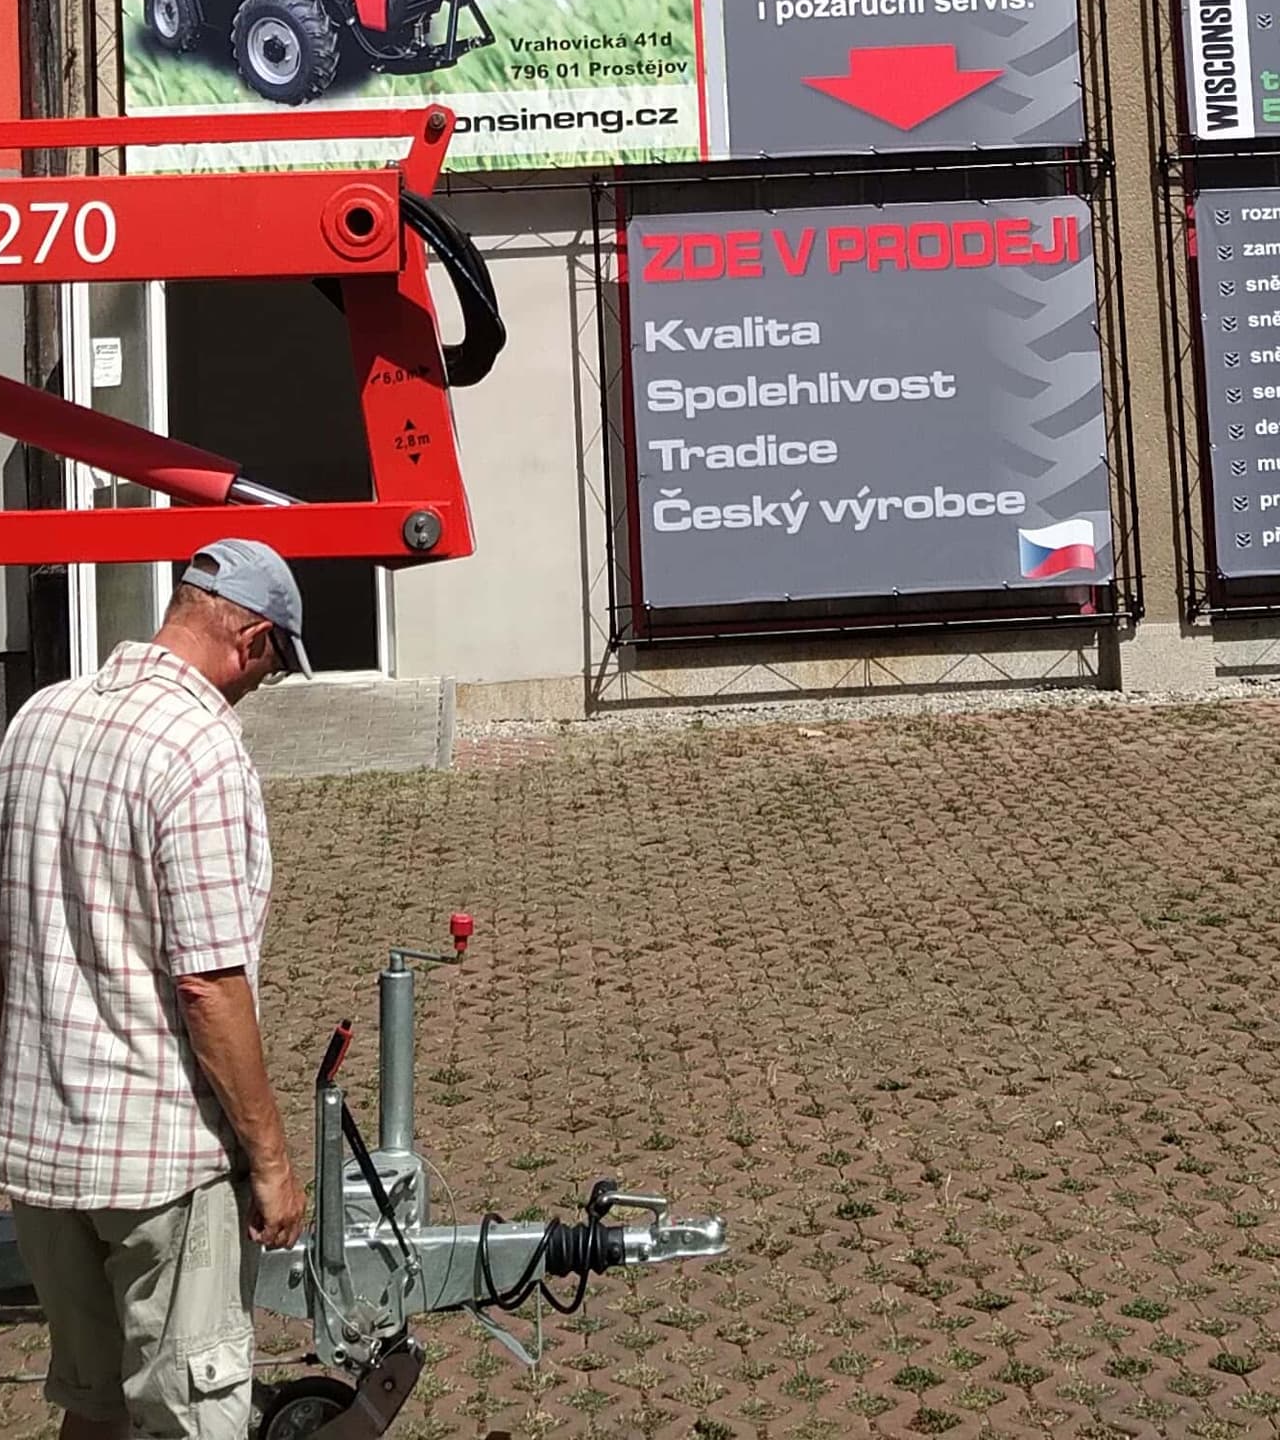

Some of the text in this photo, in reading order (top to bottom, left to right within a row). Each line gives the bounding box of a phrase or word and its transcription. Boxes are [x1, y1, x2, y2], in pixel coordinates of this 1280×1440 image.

[509, 32, 672, 52] Vrahovická 41d
[511, 60, 688, 80] 796 01 Prostějov
[453, 108, 678, 134] onsineng.cz
[641, 216, 1080, 283] ZDE V PRODEJI
[644, 315, 821, 353] Kvalita
[646, 370, 957, 418] Spolehlivost
[648, 434, 838, 471] Tradice
[652, 486, 1026, 534] Český výrobce
